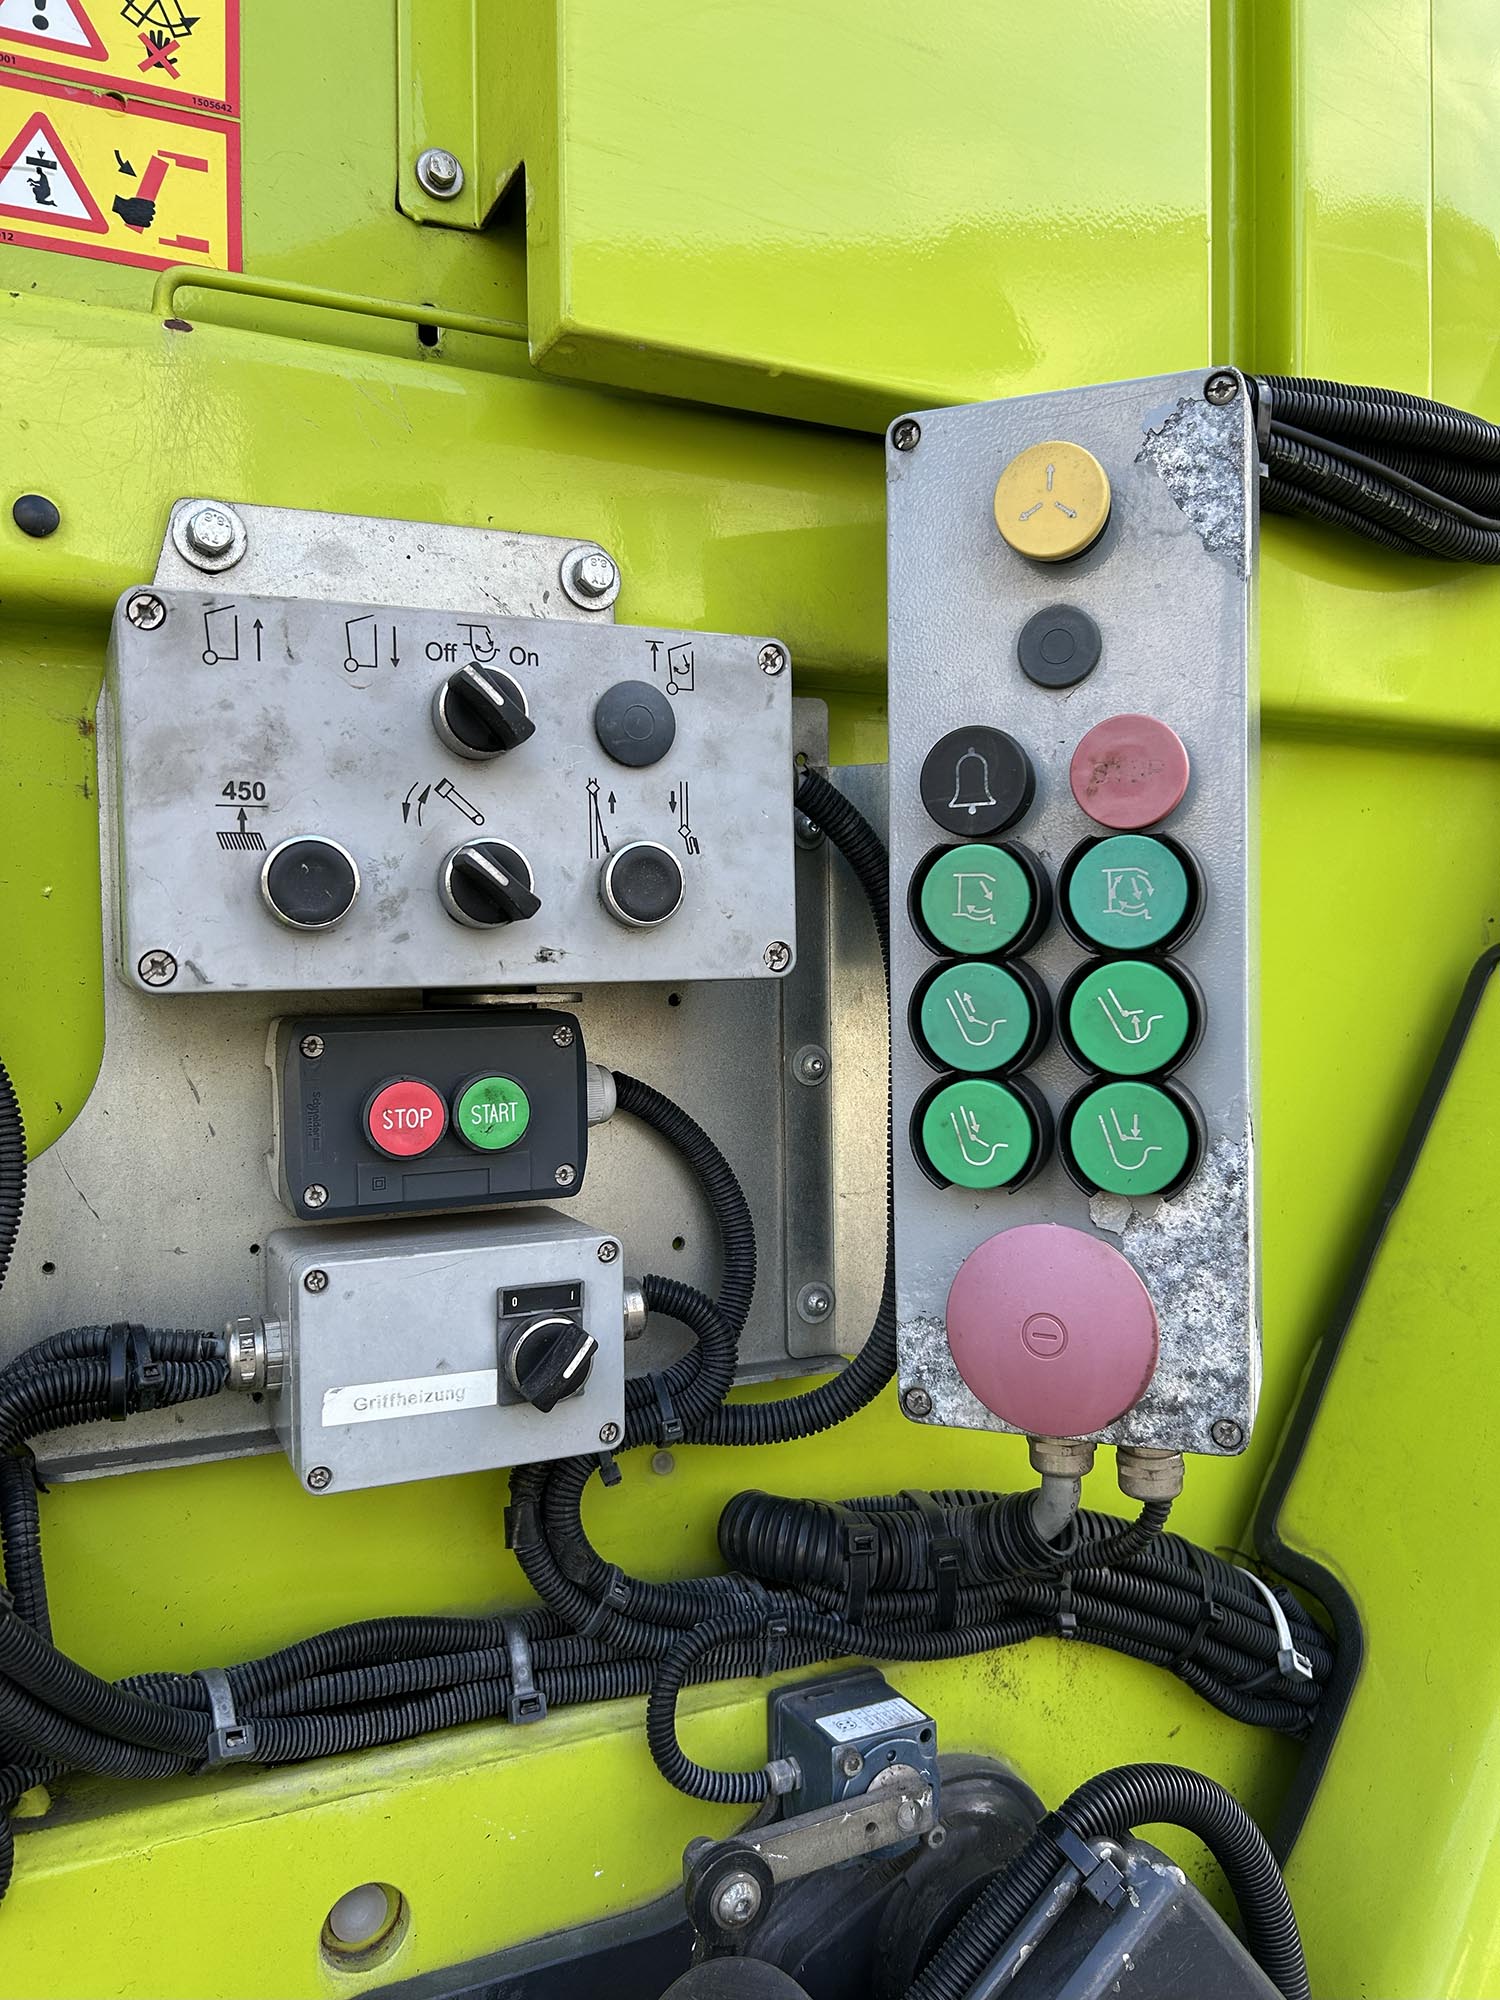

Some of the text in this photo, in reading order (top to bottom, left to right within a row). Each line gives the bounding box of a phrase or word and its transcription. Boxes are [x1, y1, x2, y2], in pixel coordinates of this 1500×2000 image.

[192, 97, 232, 113] 1505642
[0, 231, 14, 241] 12
[425, 641, 539, 666] Off On
[221, 780, 266, 801] 450
[382, 1102, 519, 1130] STOP START
[353, 1386, 466, 1411] Griffheizung
